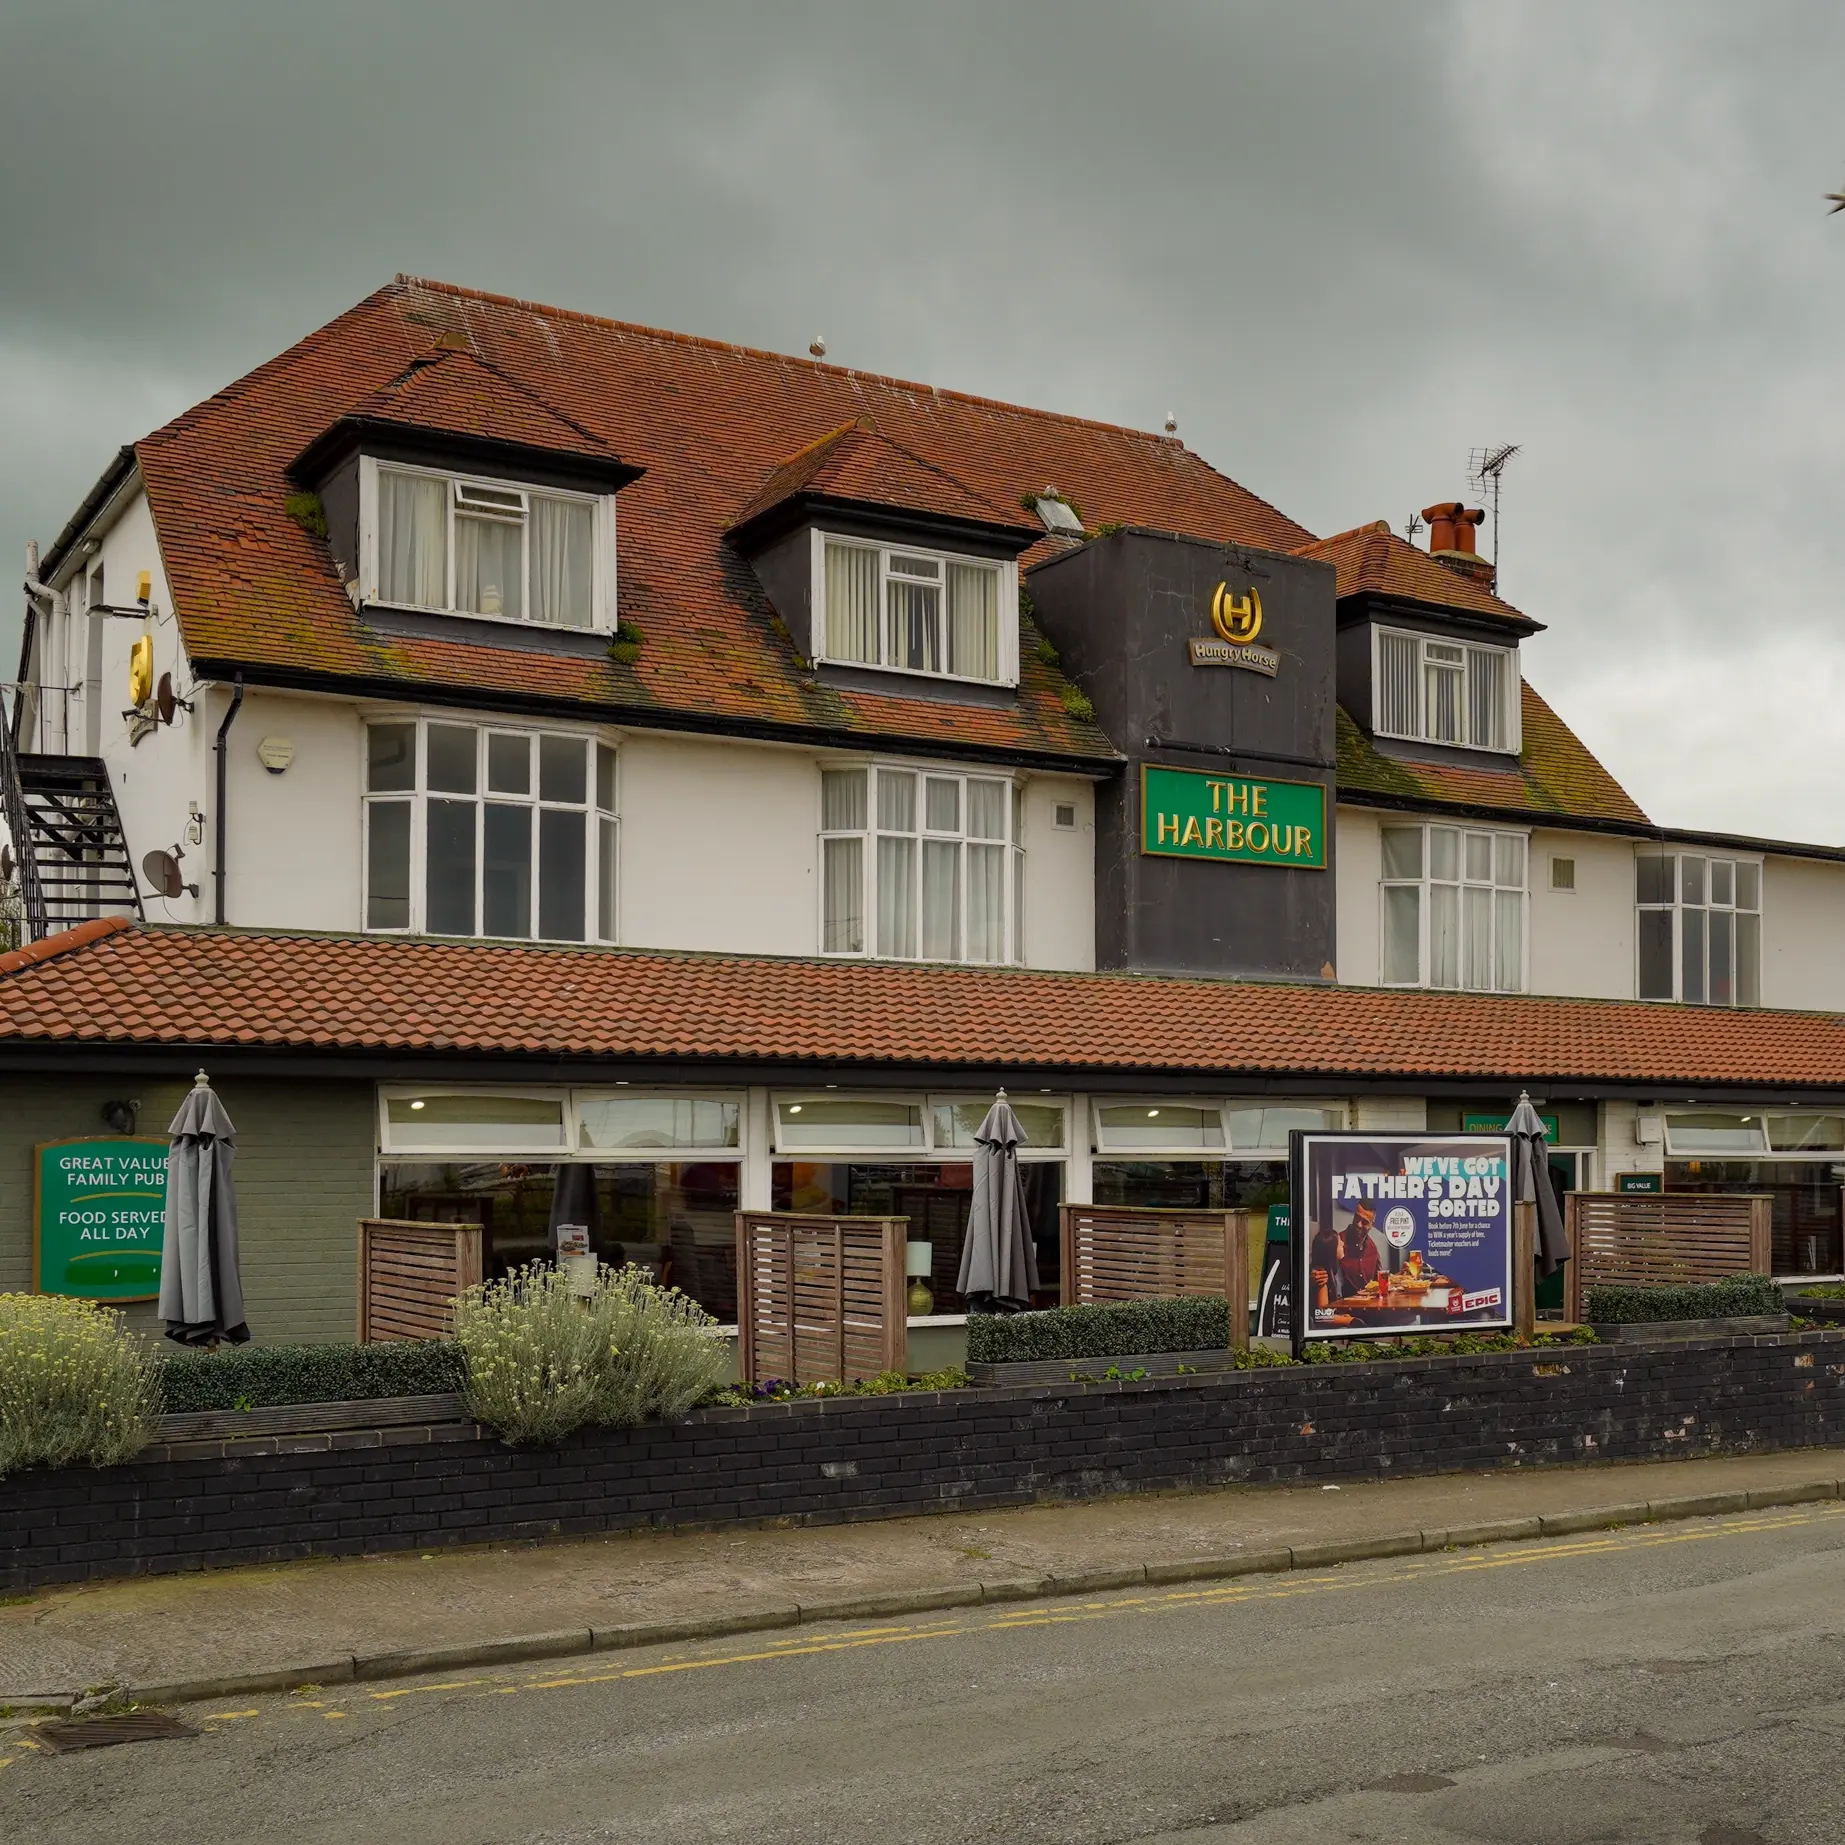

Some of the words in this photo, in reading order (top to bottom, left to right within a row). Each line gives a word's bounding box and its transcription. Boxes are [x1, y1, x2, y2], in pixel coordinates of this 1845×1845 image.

[1195, 644, 1241, 662] Hungry
[1241, 647, 1276, 669] Horse
[1205, 780, 1268, 818] THE
[1157, 812, 1314, 858] HARBOUR
[59, 1157, 114, 1170] GREAT
[118, 1157, 169, 1170] VALUE
[1403, 1156, 1459, 1175] WE'VE
[1463, 1156, 1501, 1175] GOT
[67, 1173, 130, 1186] FAMILY
[134, 1173, 165, 1186] PUB
[1331, 1175, 1443, 1199] FATHER'S
[1448, 1175, 1500, 1199] DAY
[1427, 1199, 1500, 1218] SORTED
[59, 1211, 107, 1225] FOOD
[80, 1227, 110, 1240] ALL
[116, 1227, 150, 1240] DAY
[1273, 1294, 1290, 1306] HA
[1465, 1294, 1498, 1309] EPIC
[1314, 1307, 1337, 1316] ENJOY
